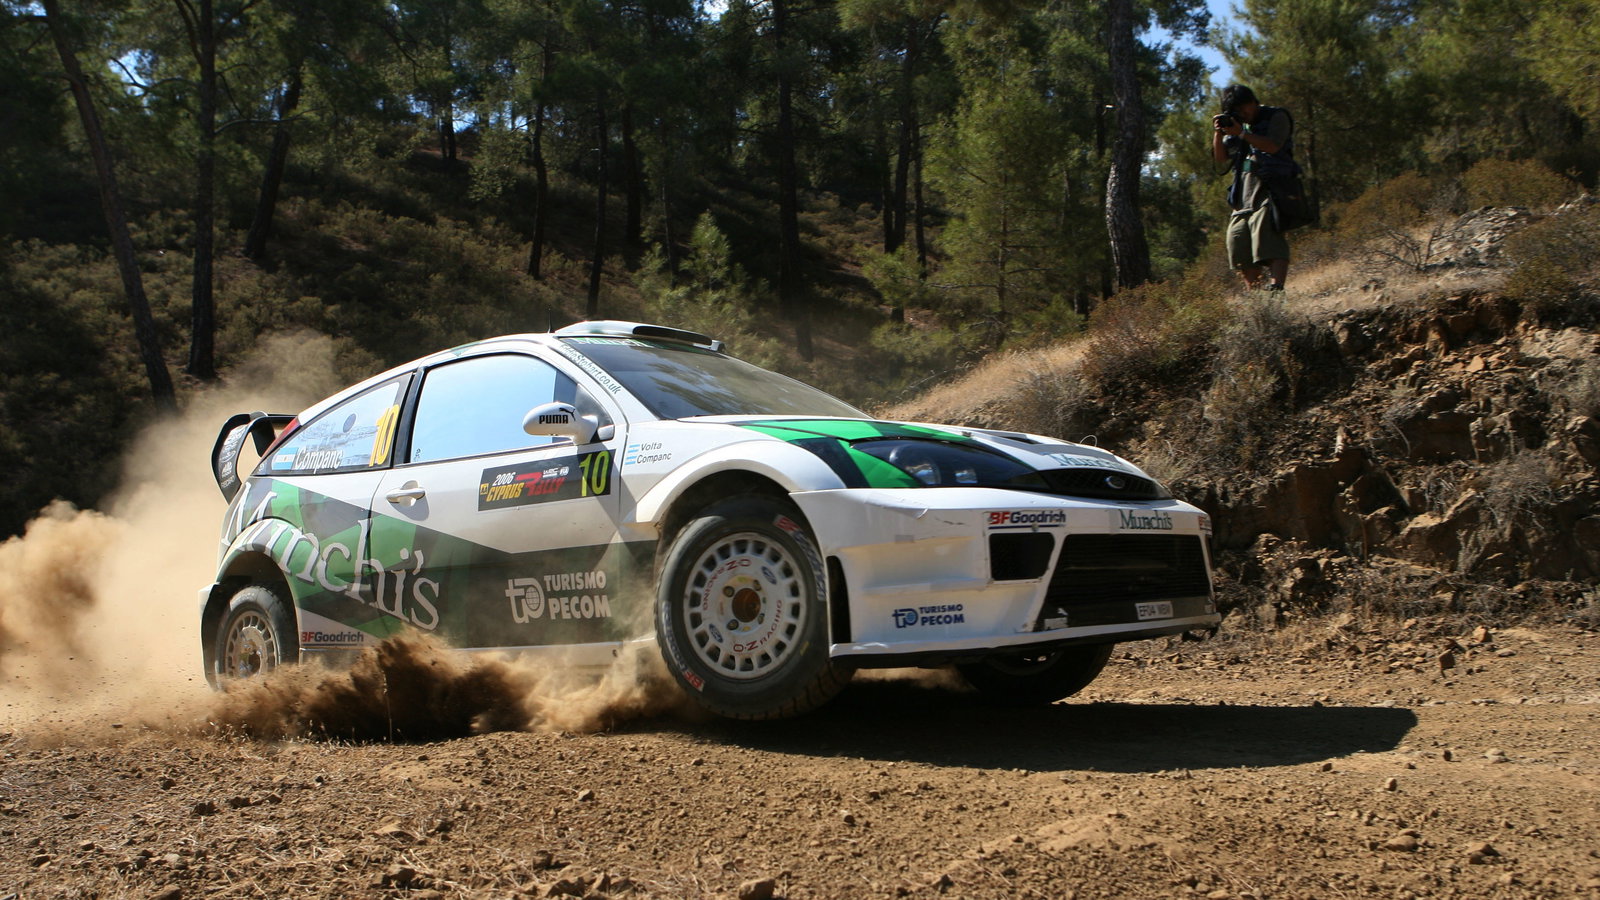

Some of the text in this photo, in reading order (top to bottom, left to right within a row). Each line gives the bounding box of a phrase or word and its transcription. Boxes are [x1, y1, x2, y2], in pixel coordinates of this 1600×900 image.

[539, 415, 569, 424] PUMA
[369, 404, 400, 467] 10
[641, 442, 662, 451] Volta
[294, 447, 344, 474] Companc
[637, 452, 672, 464] Companc
[492, 472, 516, 486] 2006
[579, 450, 610, 497] 10
[486, 483, 525, 502] CYPRUS
[990, 511, 1066, 524] BFGoodrich
[1119, 509, 1173, 530] Munchi's
[221, 482, 439, 630] Munchi's
[544, 570, 607, 592] TURISMO
[548, 595, 612, 620] PECOM
[919, 604, 963, 614] TURISMO
[921, 614, 965, 626] PECOM
[301, 631, 364, 642] BFGoodrich
